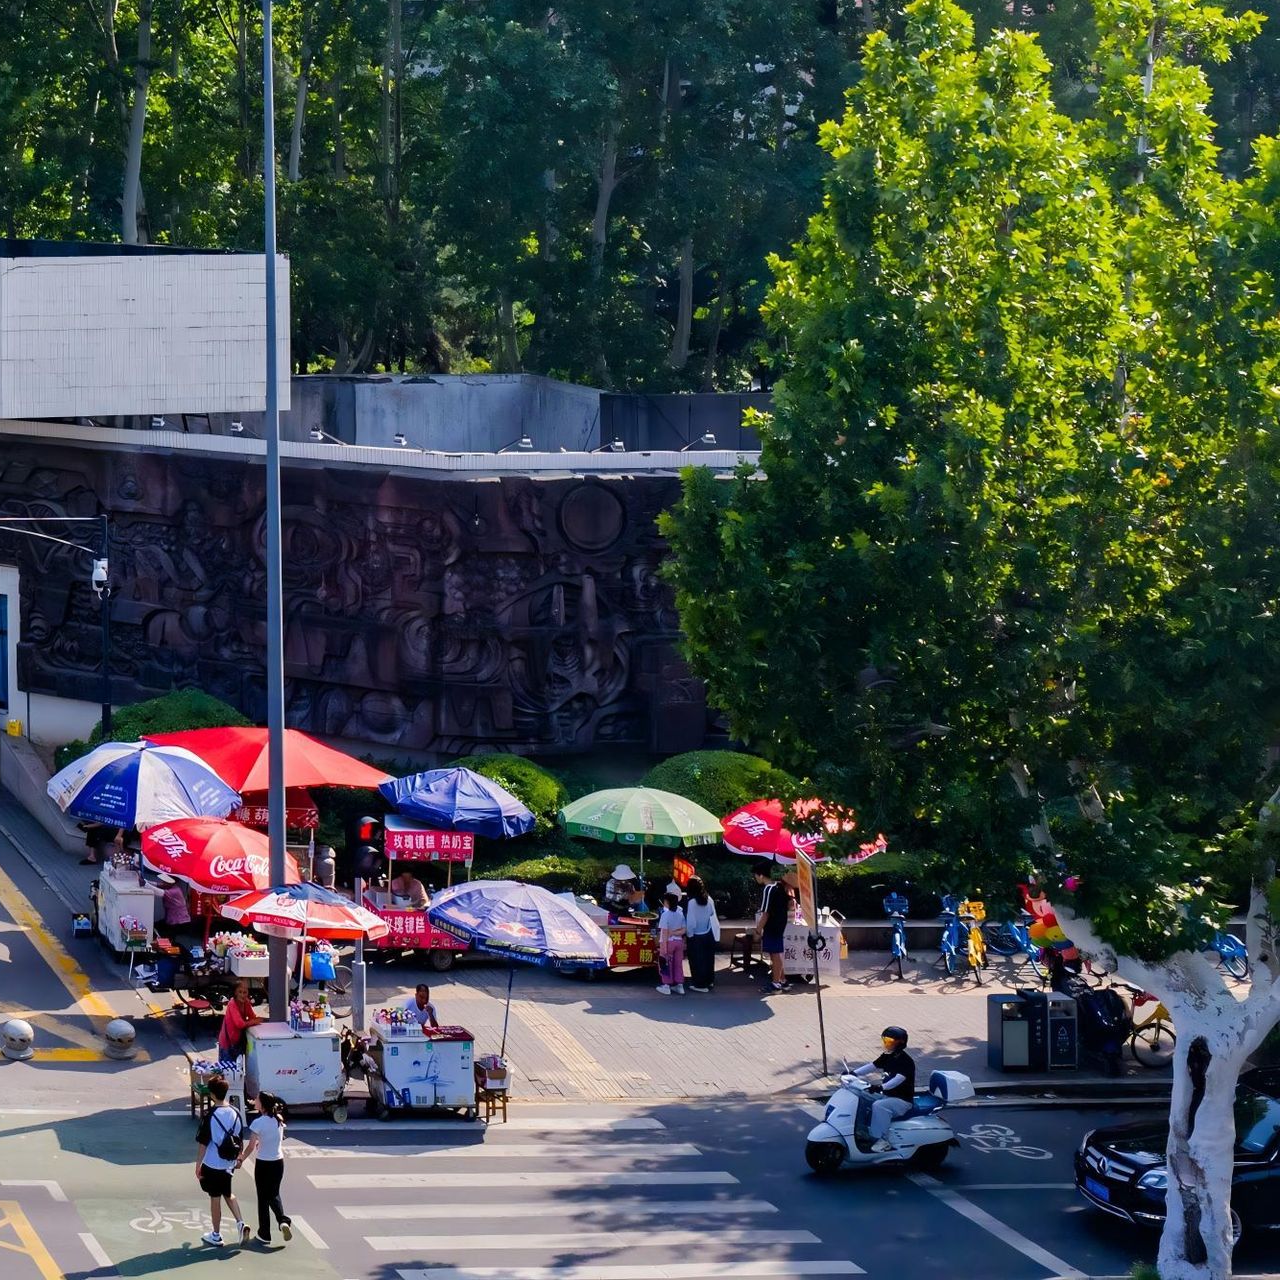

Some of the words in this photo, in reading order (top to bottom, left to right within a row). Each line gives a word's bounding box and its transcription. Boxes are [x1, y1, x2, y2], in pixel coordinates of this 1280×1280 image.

[441, 834, 472, 850] 热奶宝
[209, 854, 269, 880] Coca-Col
